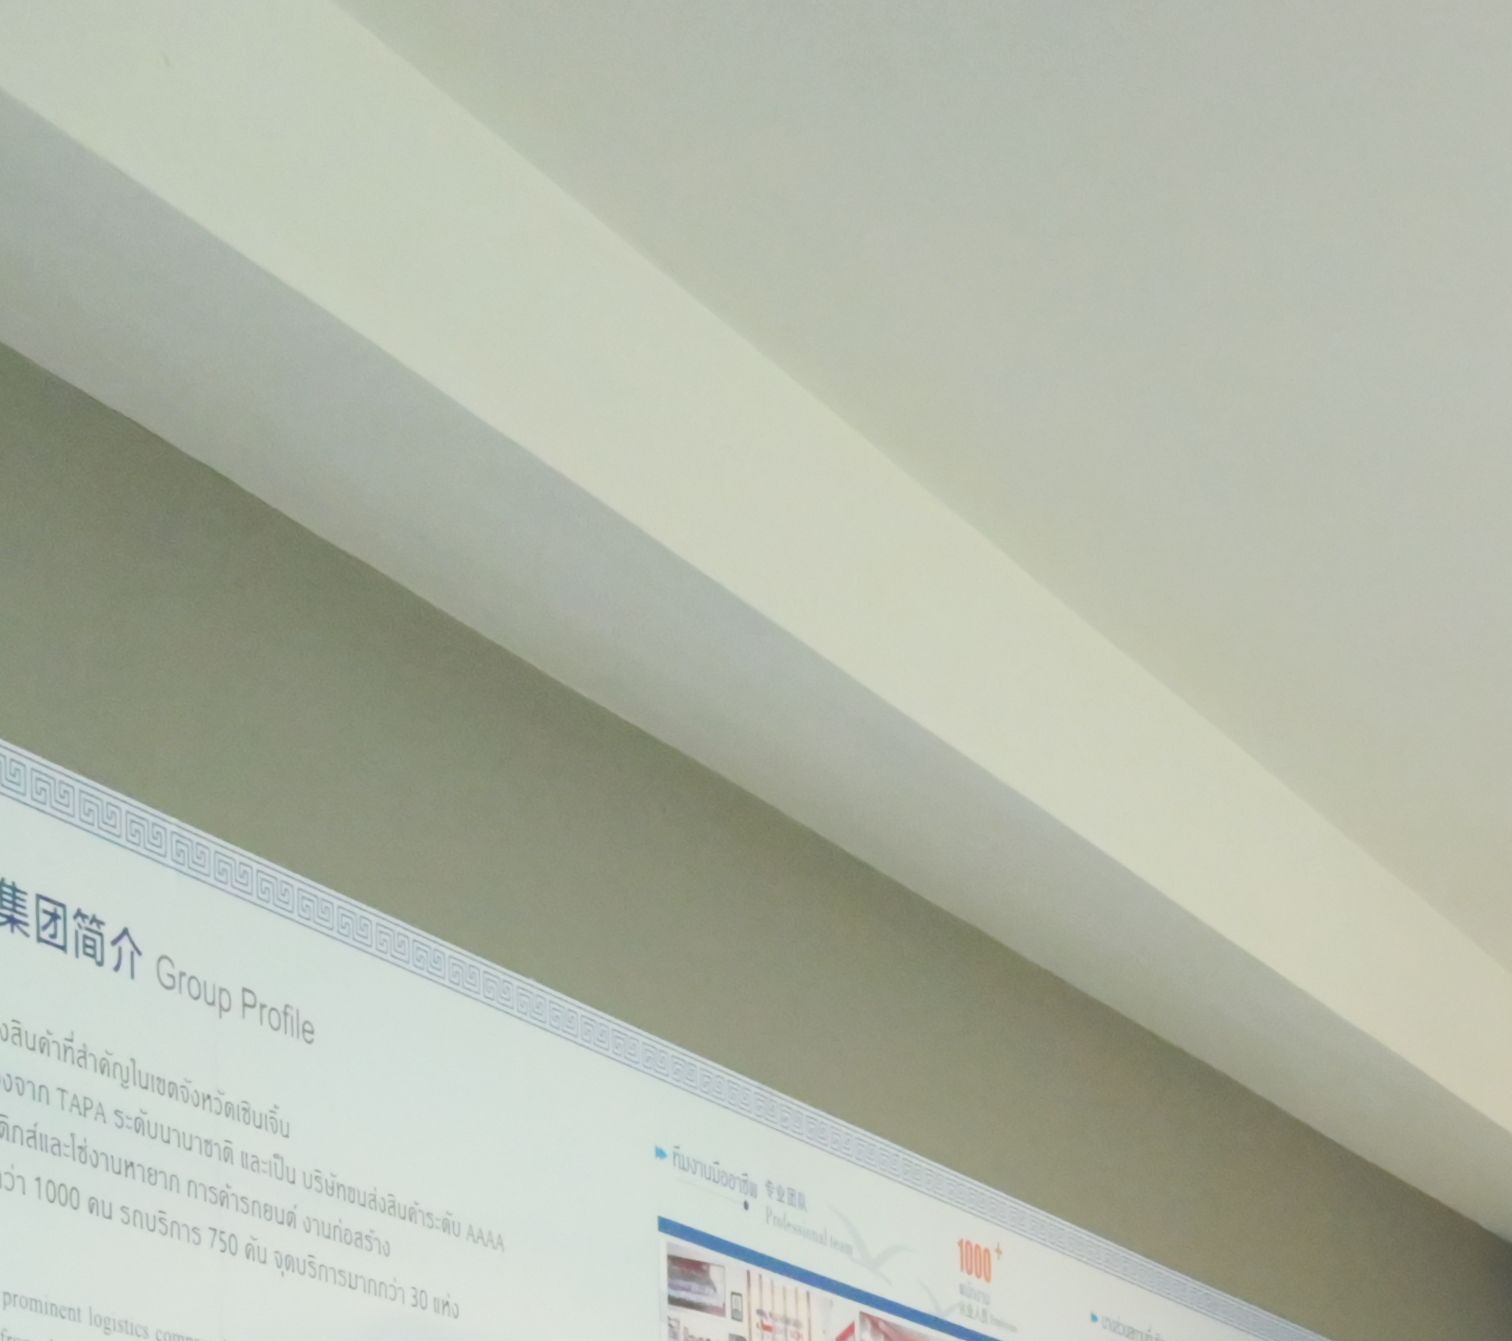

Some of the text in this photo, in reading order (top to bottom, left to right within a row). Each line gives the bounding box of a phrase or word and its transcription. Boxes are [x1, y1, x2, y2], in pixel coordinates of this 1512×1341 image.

[0, 877, 142, 980] 集团简介
[156, 954, 315, 1045] Group Profile
[56, 1087, 107, 1124] TAPA
[35, 1176, 81, 1211] 1000
[208, 1227, 238, 1257] 750
[410, 1286, 428, 1311] 30
[2, 1290, 82, 1323] prominent
[88, 1306, 150, 1340] logistics
